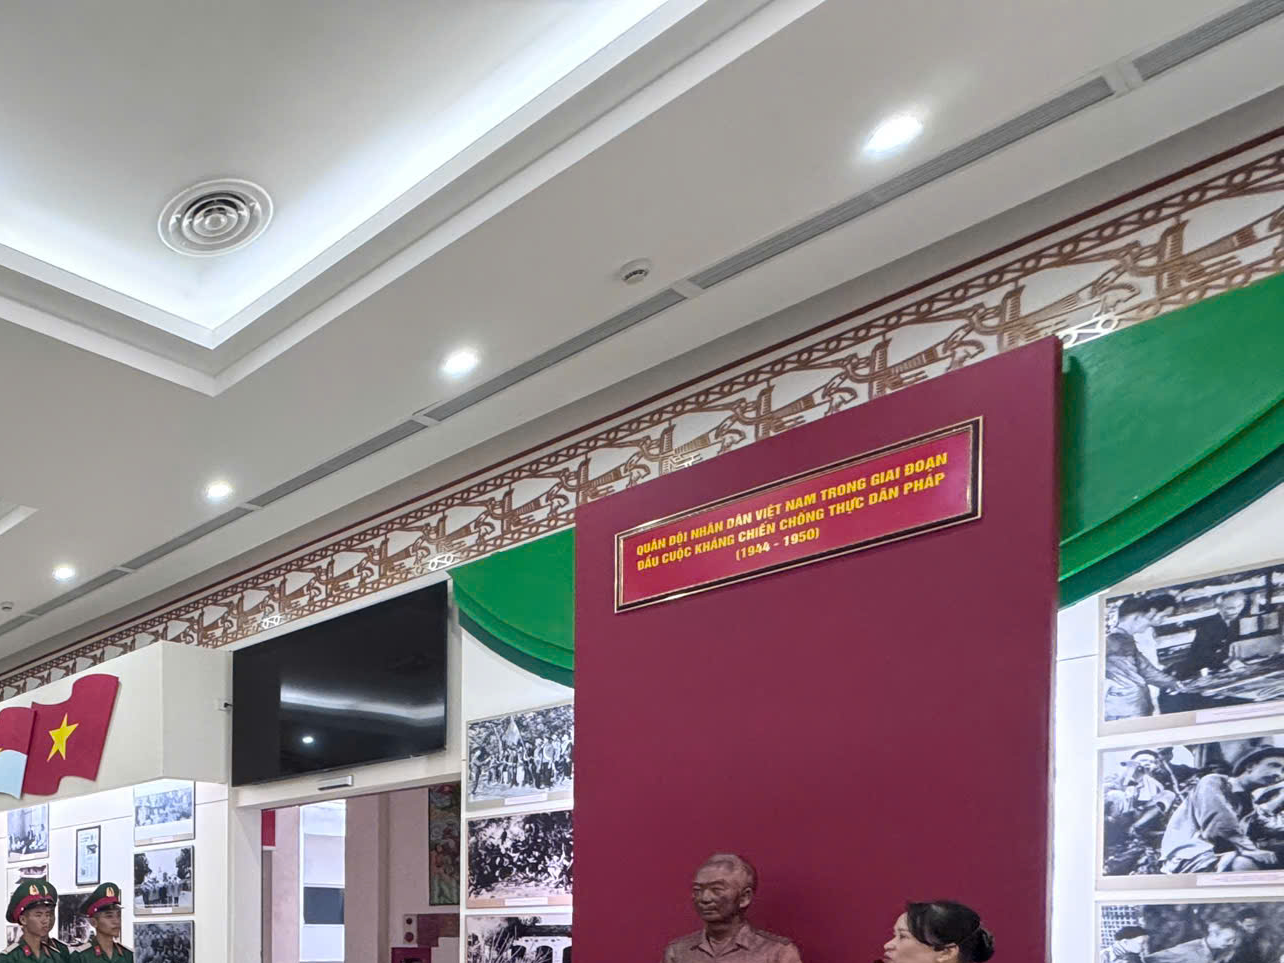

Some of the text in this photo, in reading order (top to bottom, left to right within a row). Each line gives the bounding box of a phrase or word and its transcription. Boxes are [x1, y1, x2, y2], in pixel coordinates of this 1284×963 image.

[661, 545, 692, 563] CUỘC
[694, 534, 735, 555] KHÁNG
[738, 520, 776, 543] CHIẾN
[827, 496, 864, 517] THỰC
[868, 485, 900, 506] DÂN
[903, 471, 946, 496] PHÁP
[691, 519, 724, 541] NHÂN
[726, 512, 753, 530] DÂN
[755, 503, 782, 520] VIỆT
[785, 492, 817, 512] NAM
[820, 477, 867, 501] TRONG
[870, 466, 901, 486] GIAI
[904, 452, 948, 475] ĐOẠN
[735, 541, 771, 561] (1944
[783, 527, 820, 547] 1950)
